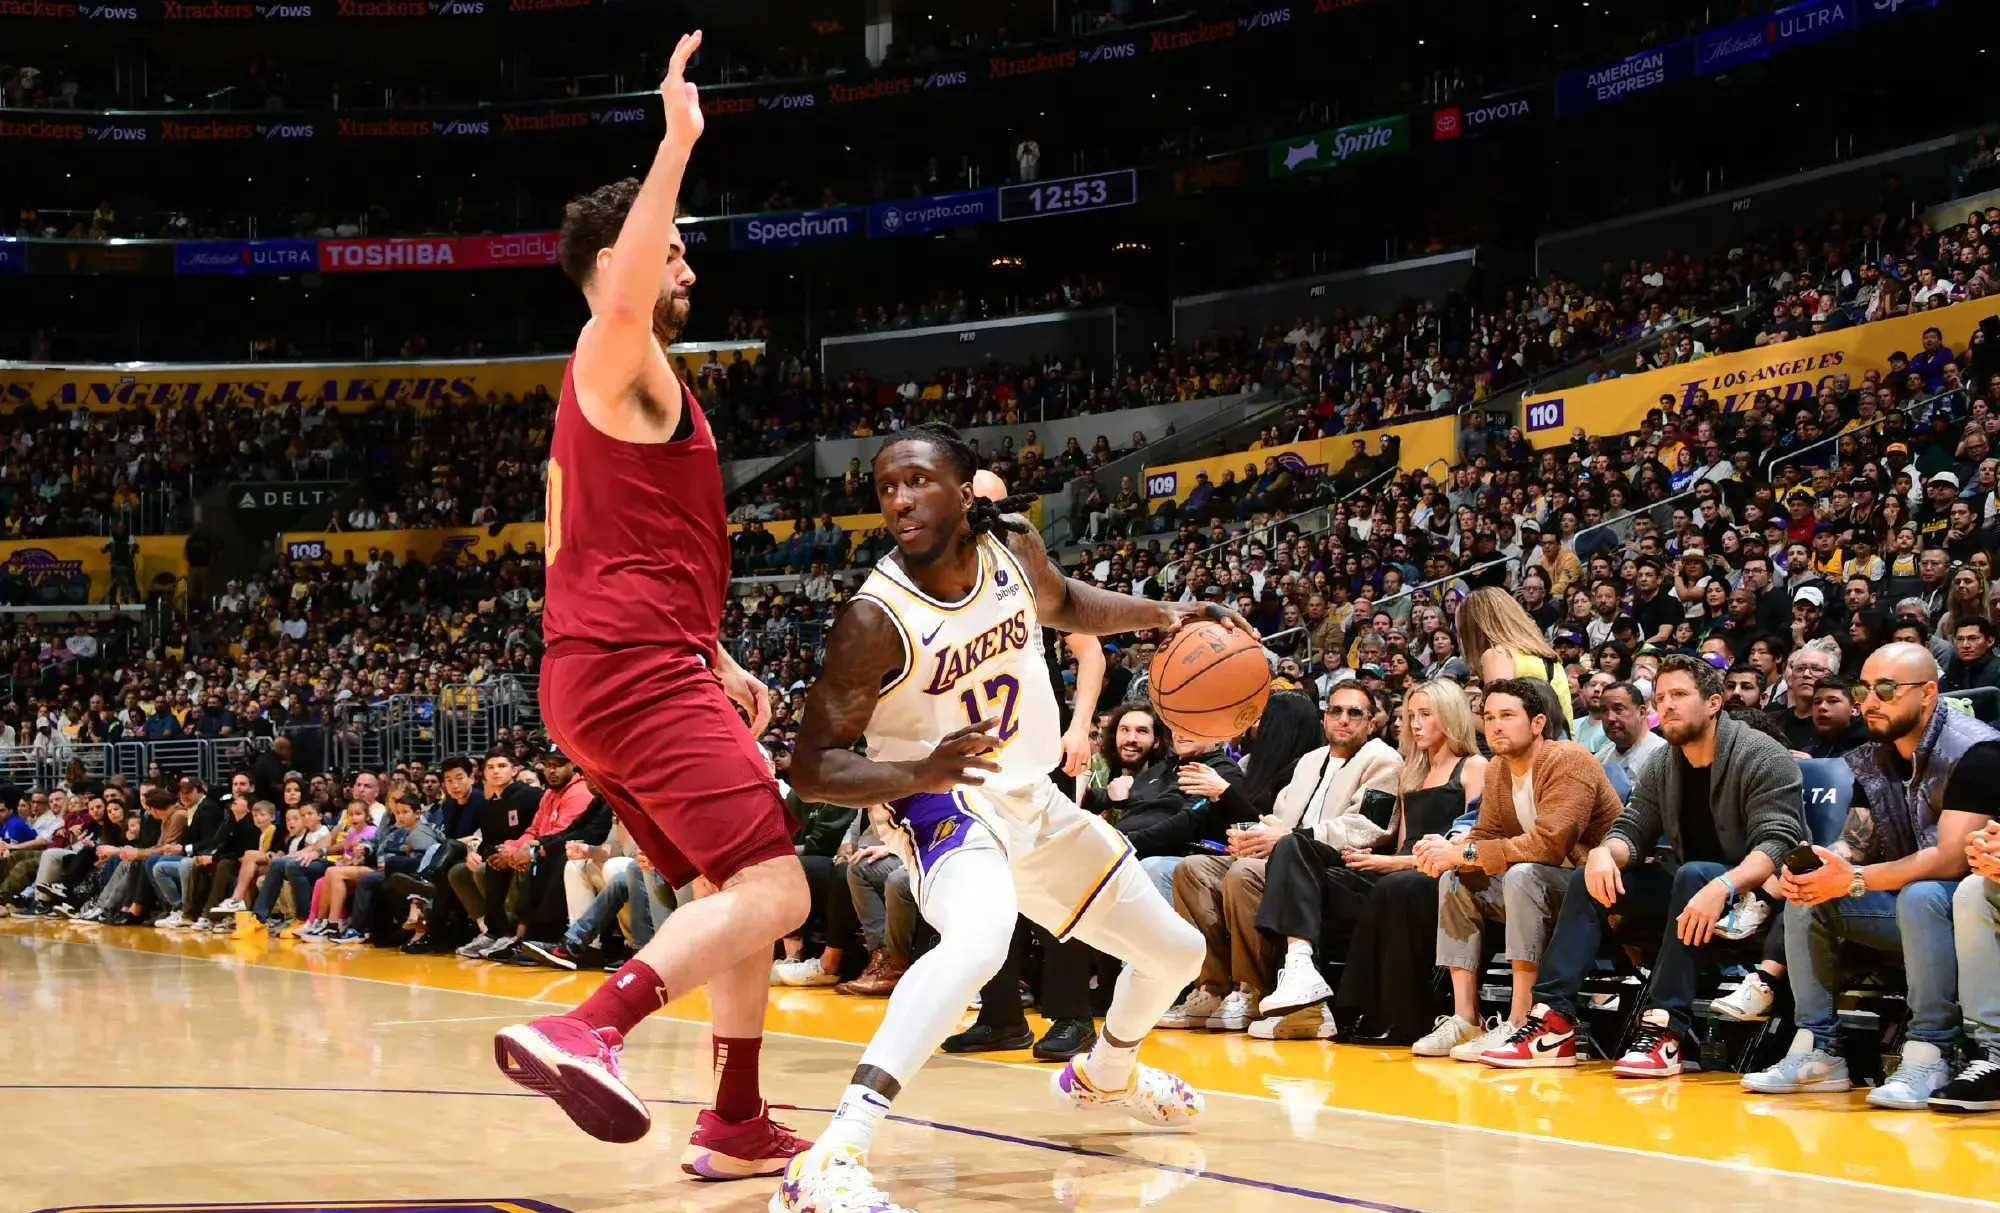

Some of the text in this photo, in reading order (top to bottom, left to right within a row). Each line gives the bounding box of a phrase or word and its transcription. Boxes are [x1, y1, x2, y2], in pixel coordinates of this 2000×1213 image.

[104, 7, 137, 19] DWS
[163, 1, 252, 19] Xtrackers
[279, 5, 312, 17] DWS
[337, 0, 428, 16] Xtrackers
[452, 2, 485, 14] DWS
[1780, 4, 1845, 37] ULTRA
[1150, 17, 1236, 53] Xtrackers
[1260, 8, 1292, 27] DWS
[988, 49, 1077, 80] Xtrackers
[1102, 43, 1135, 61] DWS
[1586, 53, 1664, 89] AMERICAN
[828, 76, 913, 105] Xtrackers
[936, 70, 968, 88] DWS
[1597, 69, 1664, 101] EXPRESS
[783, 94, 815, 109] DWS
[1465, 101, 1529, 127] TOYOTA
[0, 120, 84, 140] trackers
[113, 128, 147, 140] DWS
[161, 119, 255, 140] Xtrackers
[282, 125, 314, 138] DWS
[338, 116, 433, 137] Xtrackers
[459, 121, 489, 135] DWS
[502, 111, 591, 134] Xtrackers
[614, 108, 645, 122] DWS
[1331, 127, 1393, 160] Sprite
[1028, 180, 1108, 213] 12:53
[904, 200, 984, 225] crypto.com
[747, 216, 848, 245] Spectrum
[254, 247, 311, 264] ULTRA
[325, 243, 456, 267] TOSHIBA
[1712, 351, 1845, 390] LOS ANGELES
[280, 376, 478, 404] LAKERS
[1530, 403, 1558, 427] 110
[263, 490, 336, 506] DELT
[1148, 476, 1175, 497] 109
[290, 542, 323, 561] 108
[995, 583, 1020, 601] bibigo
[923, 610, 1028, 695] LAKERS
[960, 673, 1020, 745] 12
